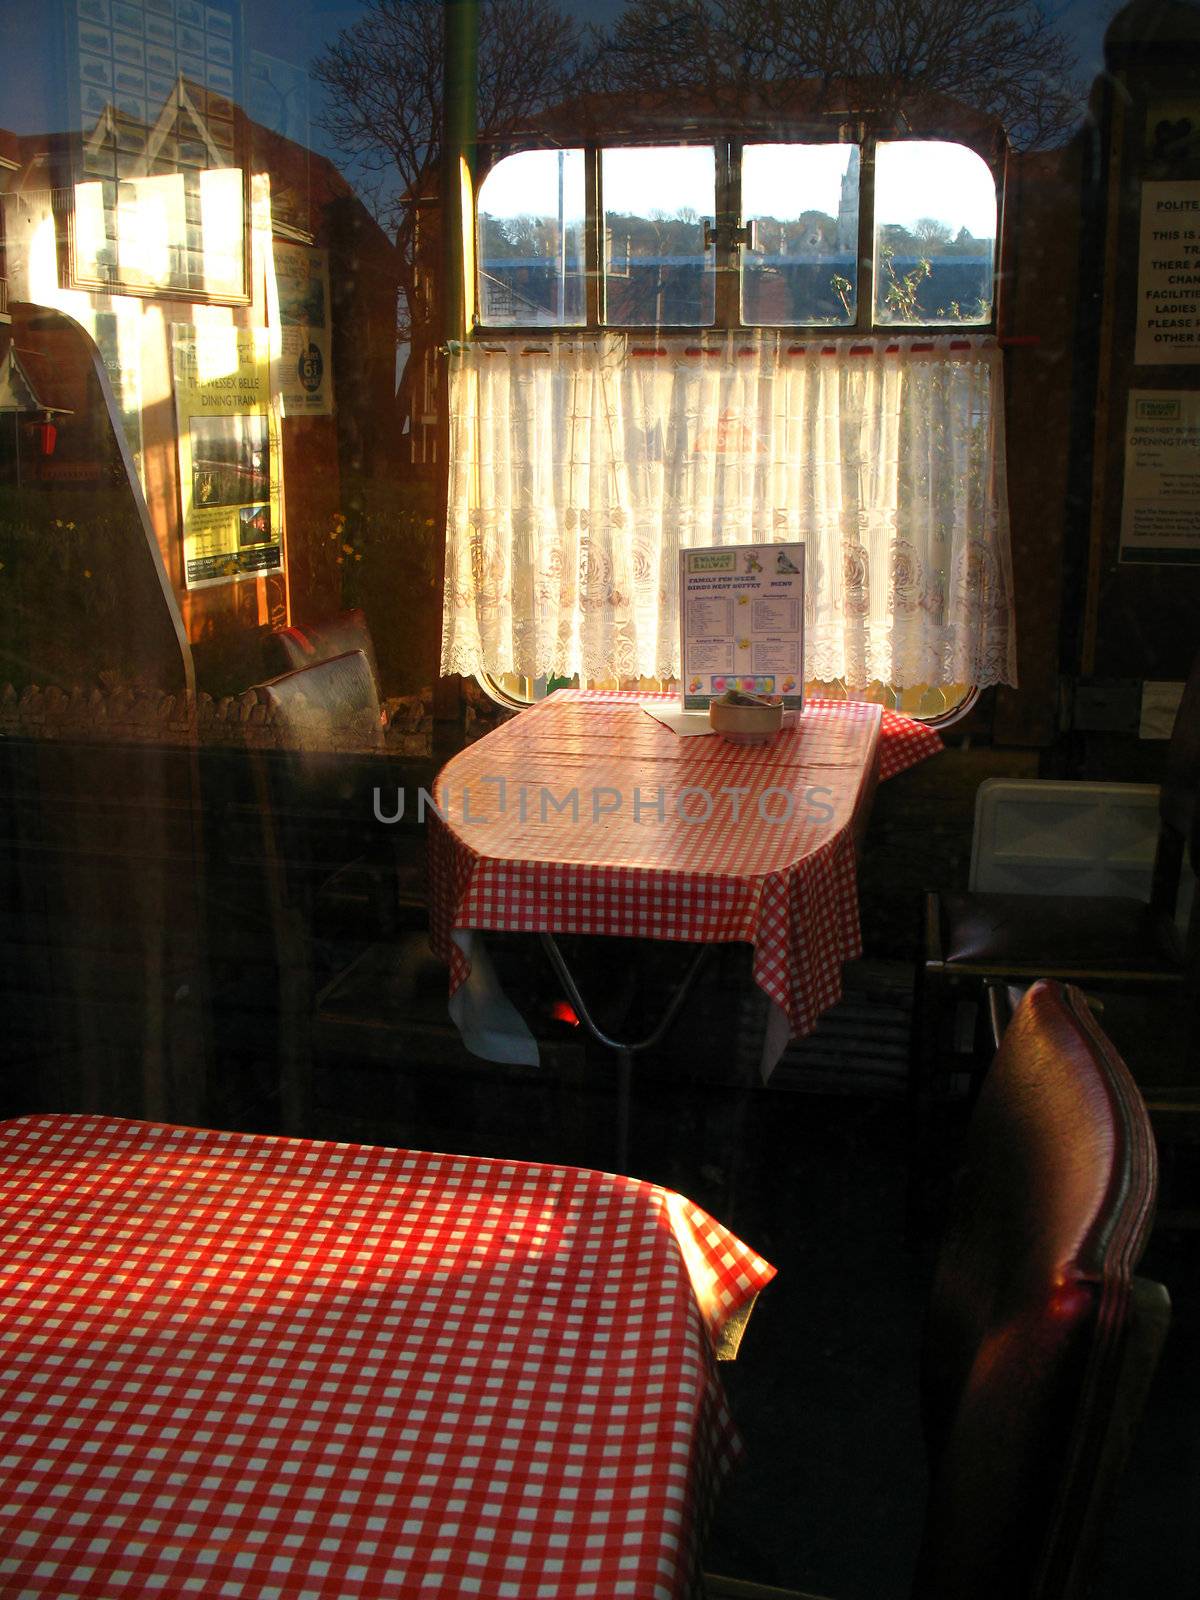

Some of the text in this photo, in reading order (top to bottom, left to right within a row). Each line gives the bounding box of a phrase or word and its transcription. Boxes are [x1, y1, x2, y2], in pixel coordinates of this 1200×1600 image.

[1157, 200, 1199, 210] POLITE
[1153, 231, 1195, 240] THIS IS
[1152, 260, 1190, 270] THERE
[1155, 304, 1197, 313] LADIES
[1147, 318, 1192, 328] PLEASE
[1153, 333, 1194, 343] OTHER
[208, 377, 236, 389] WESSEX
[239, 377, 260, 389] BELLE
[201, 394, 256, 407] DINING TRAIN
[1129, 436, 1174, 446] OPENING
[693, 561, 730, 570] RAILWAY
